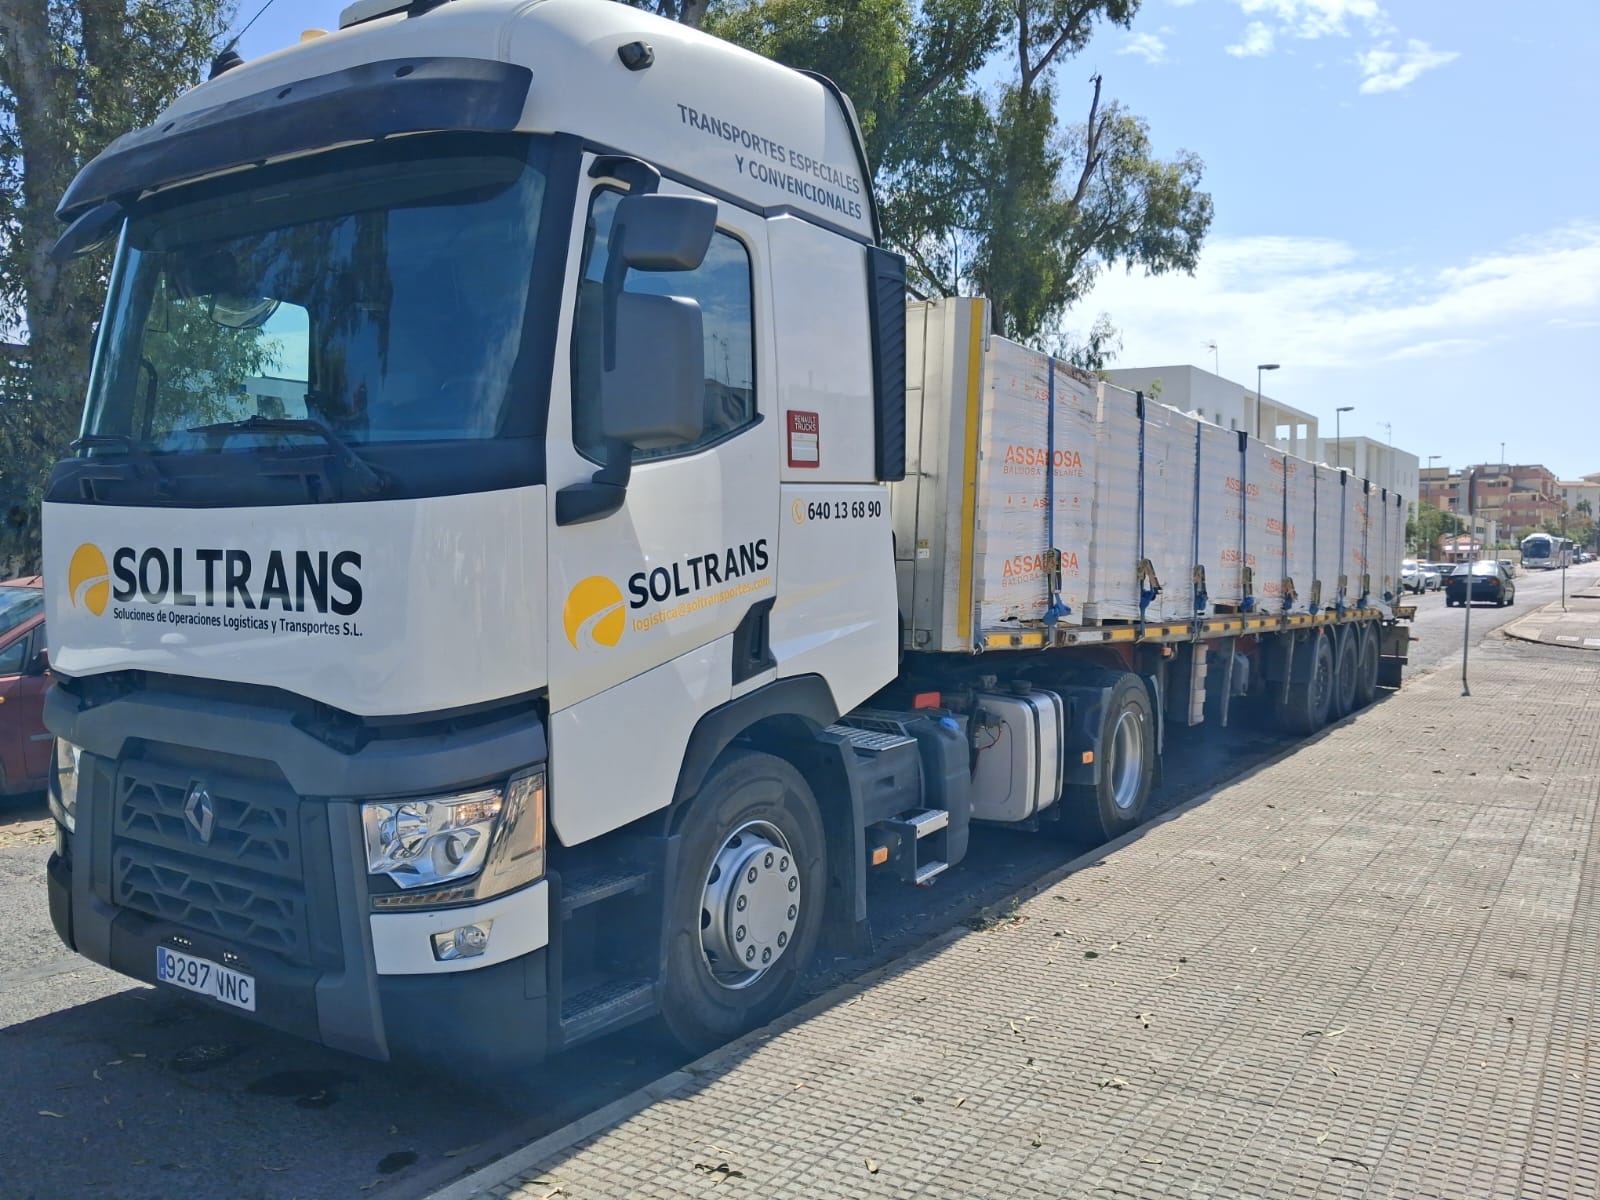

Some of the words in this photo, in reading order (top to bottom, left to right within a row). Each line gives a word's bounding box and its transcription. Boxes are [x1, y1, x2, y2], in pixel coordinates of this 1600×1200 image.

[676, 103, 786, 164] TRANSPORTES
[788, 149, 860, 195] ESPECIALES
[735, 153, 744, 174] Y
[748, 160, 862, 220] CONVENCIONALES
[794, 414, 816, 423] RENAULT
[795, 422, 817, 431] TRUCKS
[1004, 445, 1083, 468] ASSAOSA
[807, 502, 831, 520] 640
[834, 501, 848, 519] 13
[851, 501, 865, 518] 68
[867, 500, 881, 518] 90
[112, 546, 363, 616] SOLTRANS
[627, 538, 769, 609] SOLTRANS
[632, 575, 772, 632] logistica@soltransportes.com
[113, 607, 155, 622] Soluciones
[156, 610, 167, 623] de
[168, 611, 221, 627] Operaciones
[279, 618, 340, 636] Transportes
[342, 622, 363, 637] S.L.
[166, 954, 210, 989] 9297
